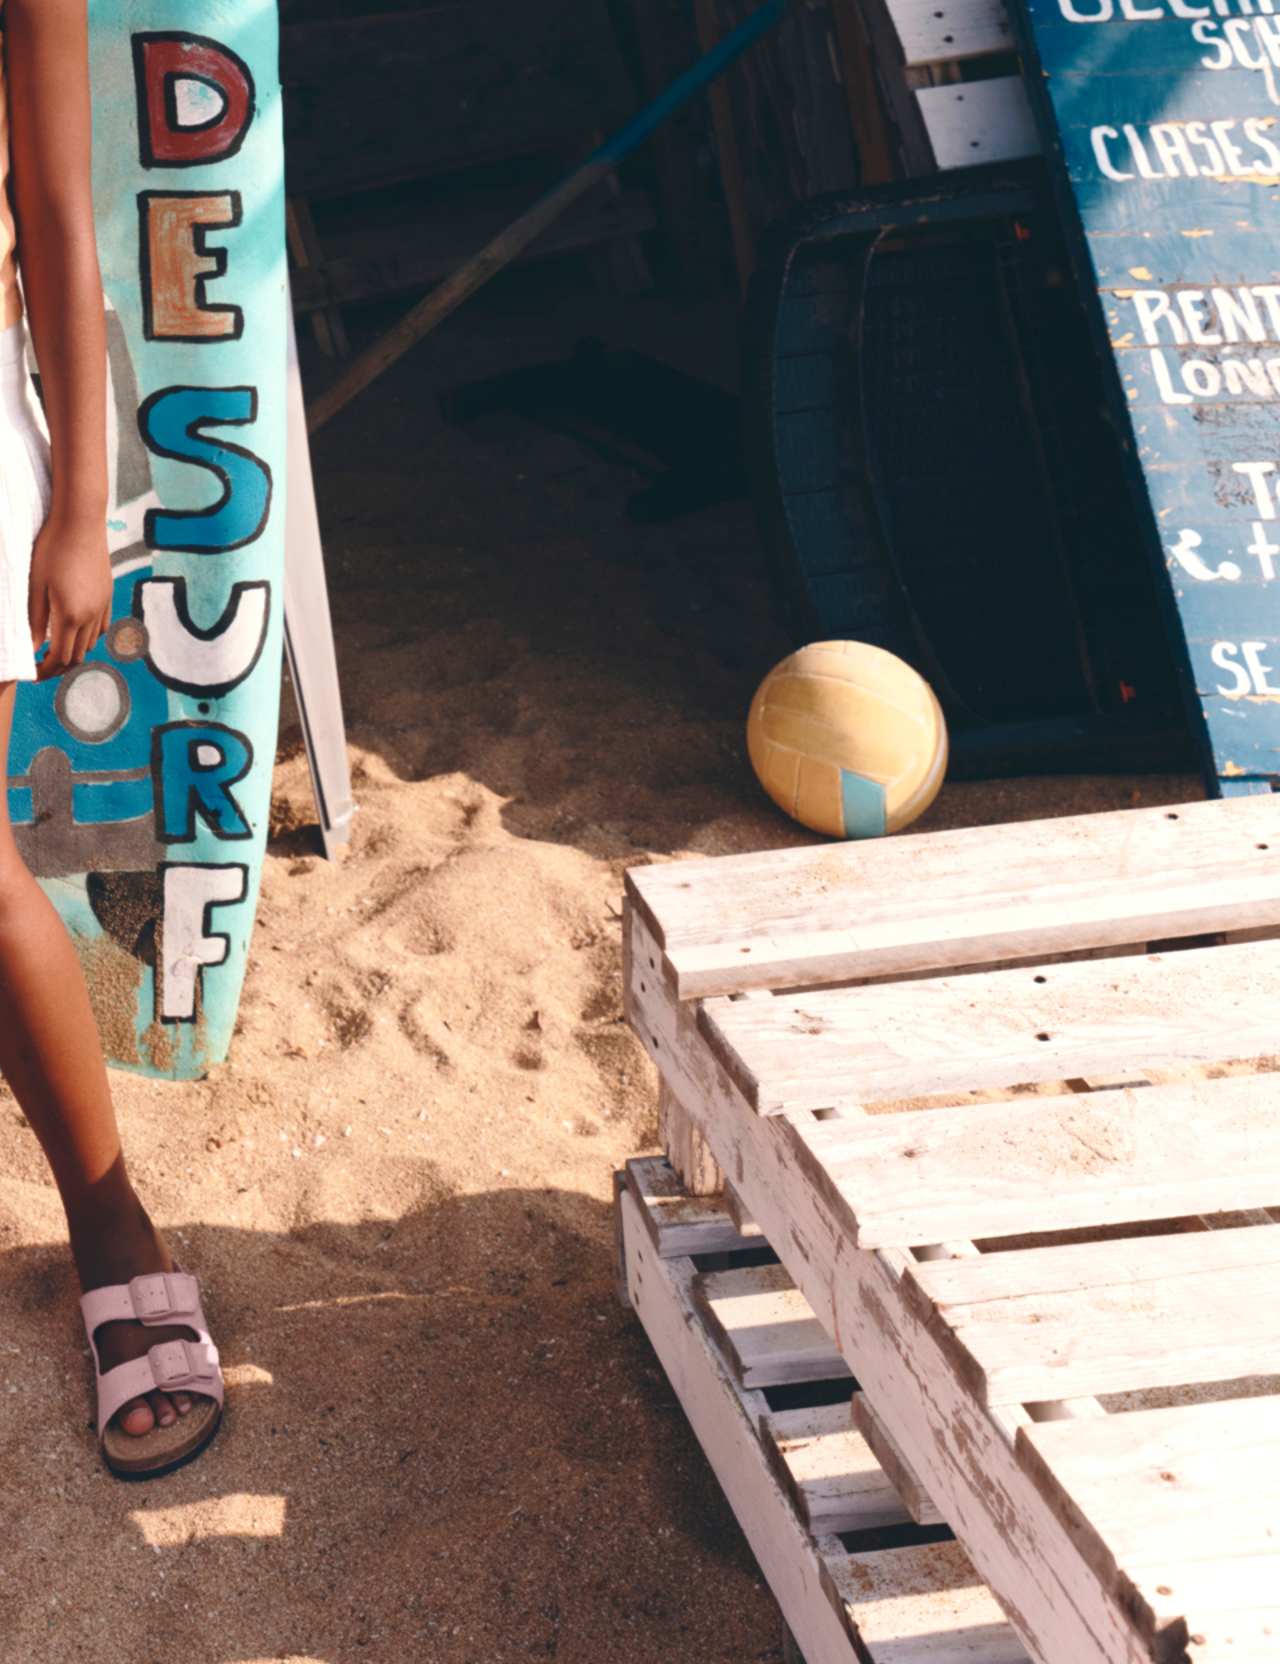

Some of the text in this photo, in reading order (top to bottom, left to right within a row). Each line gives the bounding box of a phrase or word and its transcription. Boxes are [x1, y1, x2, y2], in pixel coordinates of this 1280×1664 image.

[130, 31, 255, 342] DE
[1091, 118, 1280, 181] CLASES
[133, 385, 273, 1025] SURF
